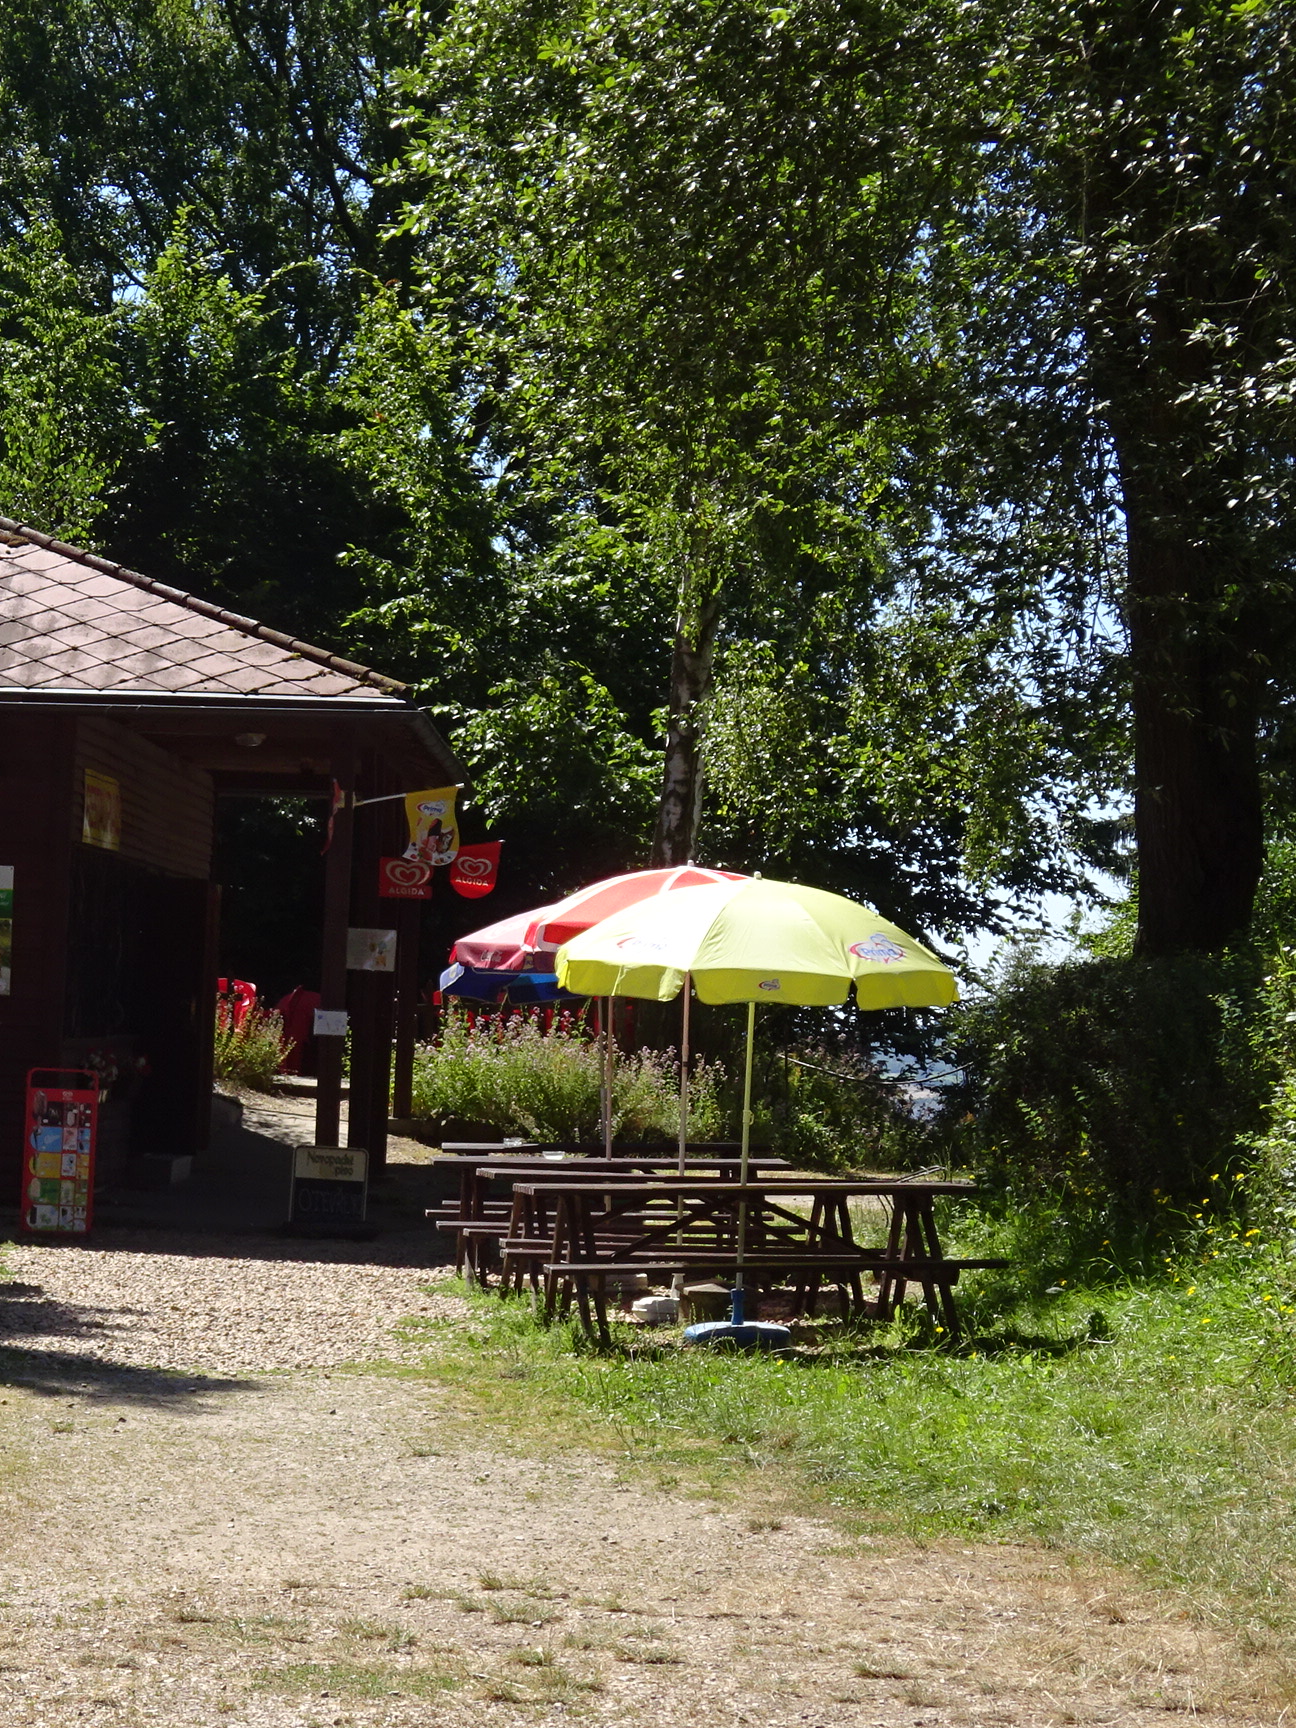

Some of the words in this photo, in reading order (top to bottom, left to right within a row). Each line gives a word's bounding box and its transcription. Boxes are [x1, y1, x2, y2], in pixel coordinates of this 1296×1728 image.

[455, 876, 489, 887] ALGIDA
[388, 886, 425, 896] ALGIDA
[860, 947, 899, 957] Prima
